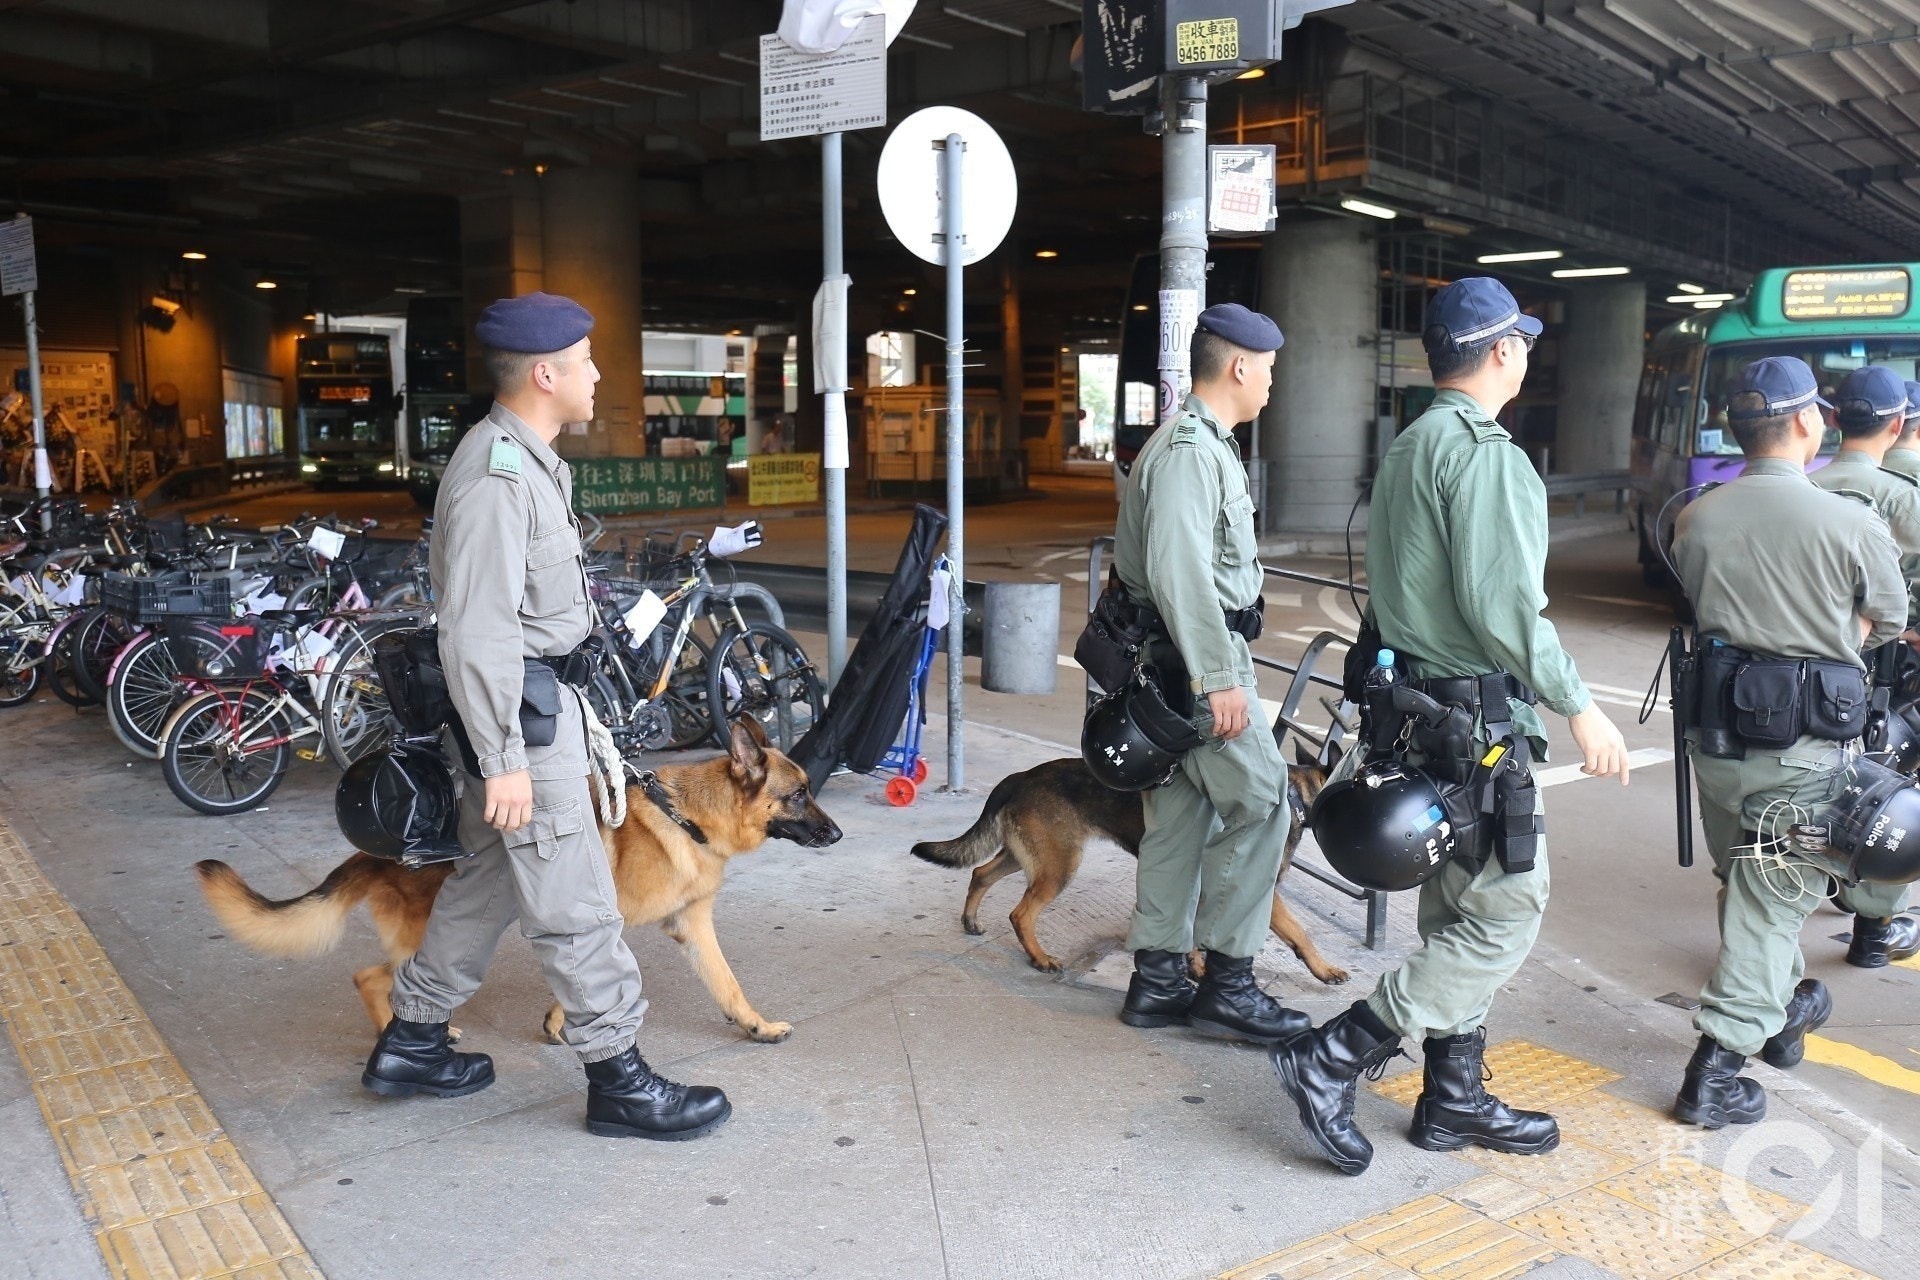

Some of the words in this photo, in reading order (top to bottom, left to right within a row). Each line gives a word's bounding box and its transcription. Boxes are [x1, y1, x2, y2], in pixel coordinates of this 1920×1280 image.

[1179, 46, 1206, 62] 9456
[1210, 43, 1237, 59] 7889
[581, 487, 649, 508] Shenzhen
[657, 486, 681, 507] Bay
[688, 486, 715, 503] Port
[1865, 814, 1891, 847] Police
[1886, 827, 1907, 853] 警察
